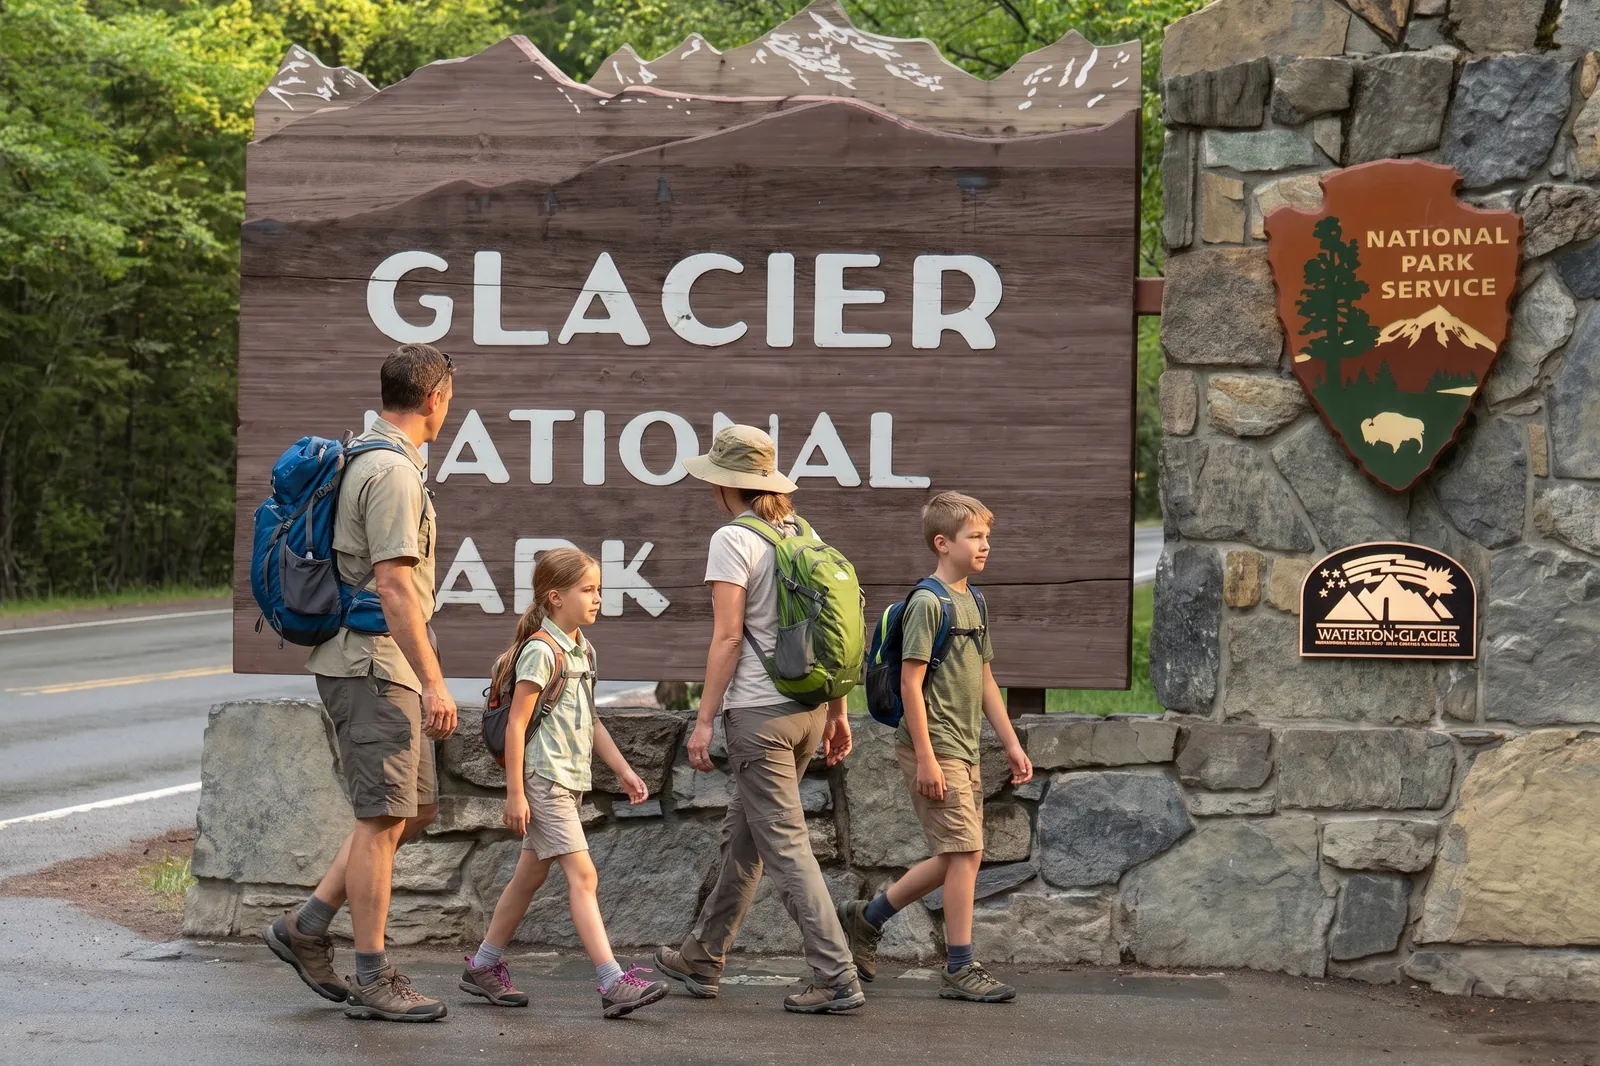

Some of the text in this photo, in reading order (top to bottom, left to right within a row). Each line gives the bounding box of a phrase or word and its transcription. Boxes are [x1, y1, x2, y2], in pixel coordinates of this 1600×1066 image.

[1366, 226, 1510, 248] NATIONAL
[1381, 277, 1496, 299] SERVICE
[1401, 253, 1474, 273] PARK
[366, 250, 1004, 350] GLACIER
[364, 409, 932, 489] ATIOAL
[434, 536, 671, 618] AK
